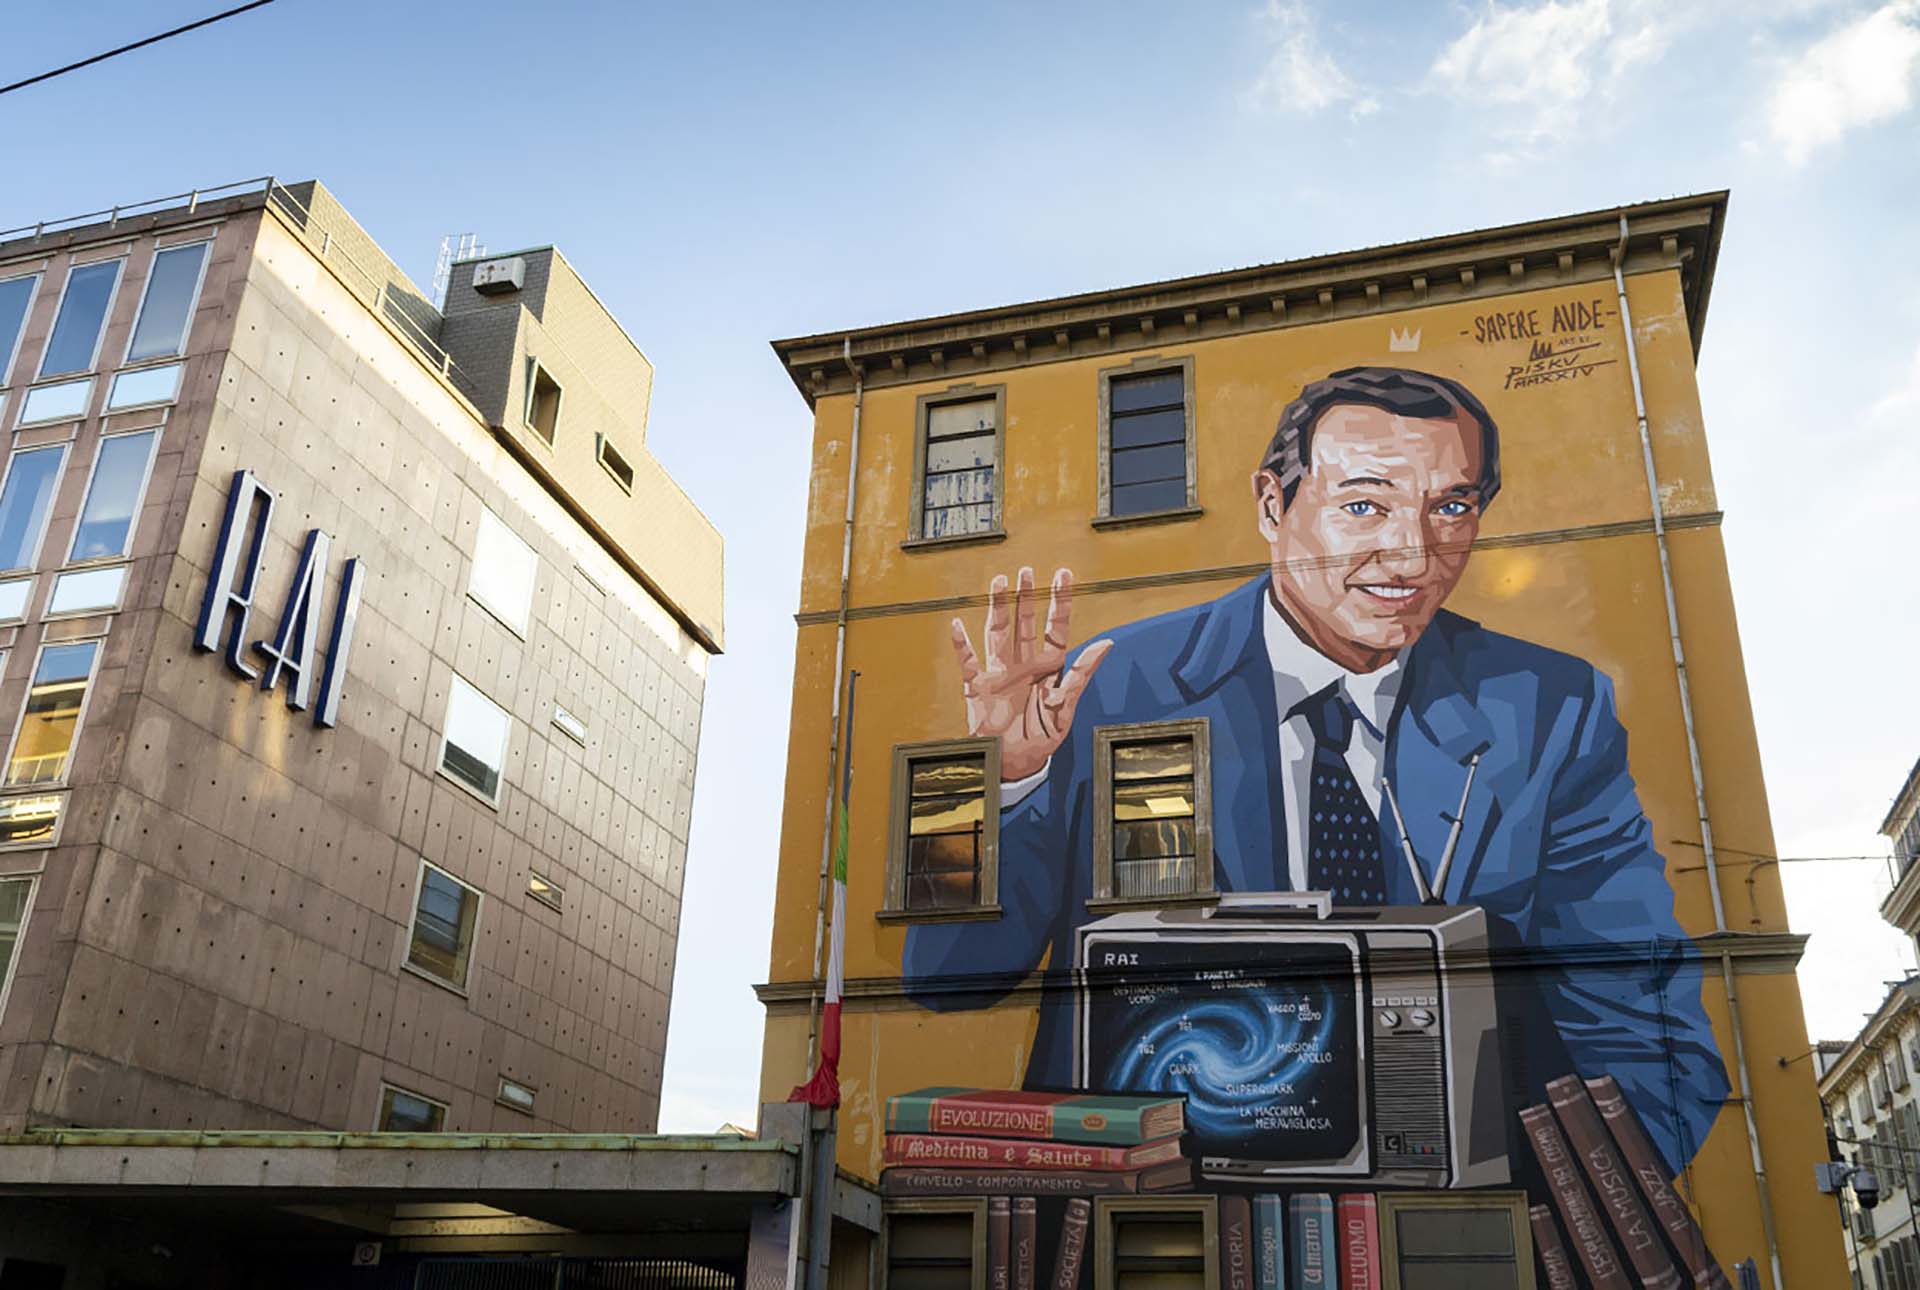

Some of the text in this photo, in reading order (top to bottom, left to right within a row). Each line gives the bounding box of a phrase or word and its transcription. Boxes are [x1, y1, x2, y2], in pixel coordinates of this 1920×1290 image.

[193, 469, 367, 729] RAI
[1104, 953, 1139, 966] RAI
[1128, 993, 1156, 1005] UOMO
[1138, 1043, 1155, 1055] TG2
[1297, 1051, 1333, 1064] APOLLO
[1225, 1082, 1295, 1097] SUPERQUARK
[1239, 1105, 1306, 1118] LA MACCHINA
[940, 1109, 1047, 1132] EVOLUZIONE
[1255, 1117, 1332, 1130] MERAVIGLIOSA
[906, 1137, 990, 1160] Medicina
[1026, 1147, 1093, 1167] Salute
[905, 1175, 963, 1188] CERVELLO
[976, 1176, 1083, 1191] COMPORTAMENTO
[1588, 1144, 1652, 1250] LA MUSICA
[1638, 1162, 1689, 1232] IL JAZZ
[1228, 1221, 1245, 1290] STORIA
[1263, 1225, 1277, 1284] Ecologia
